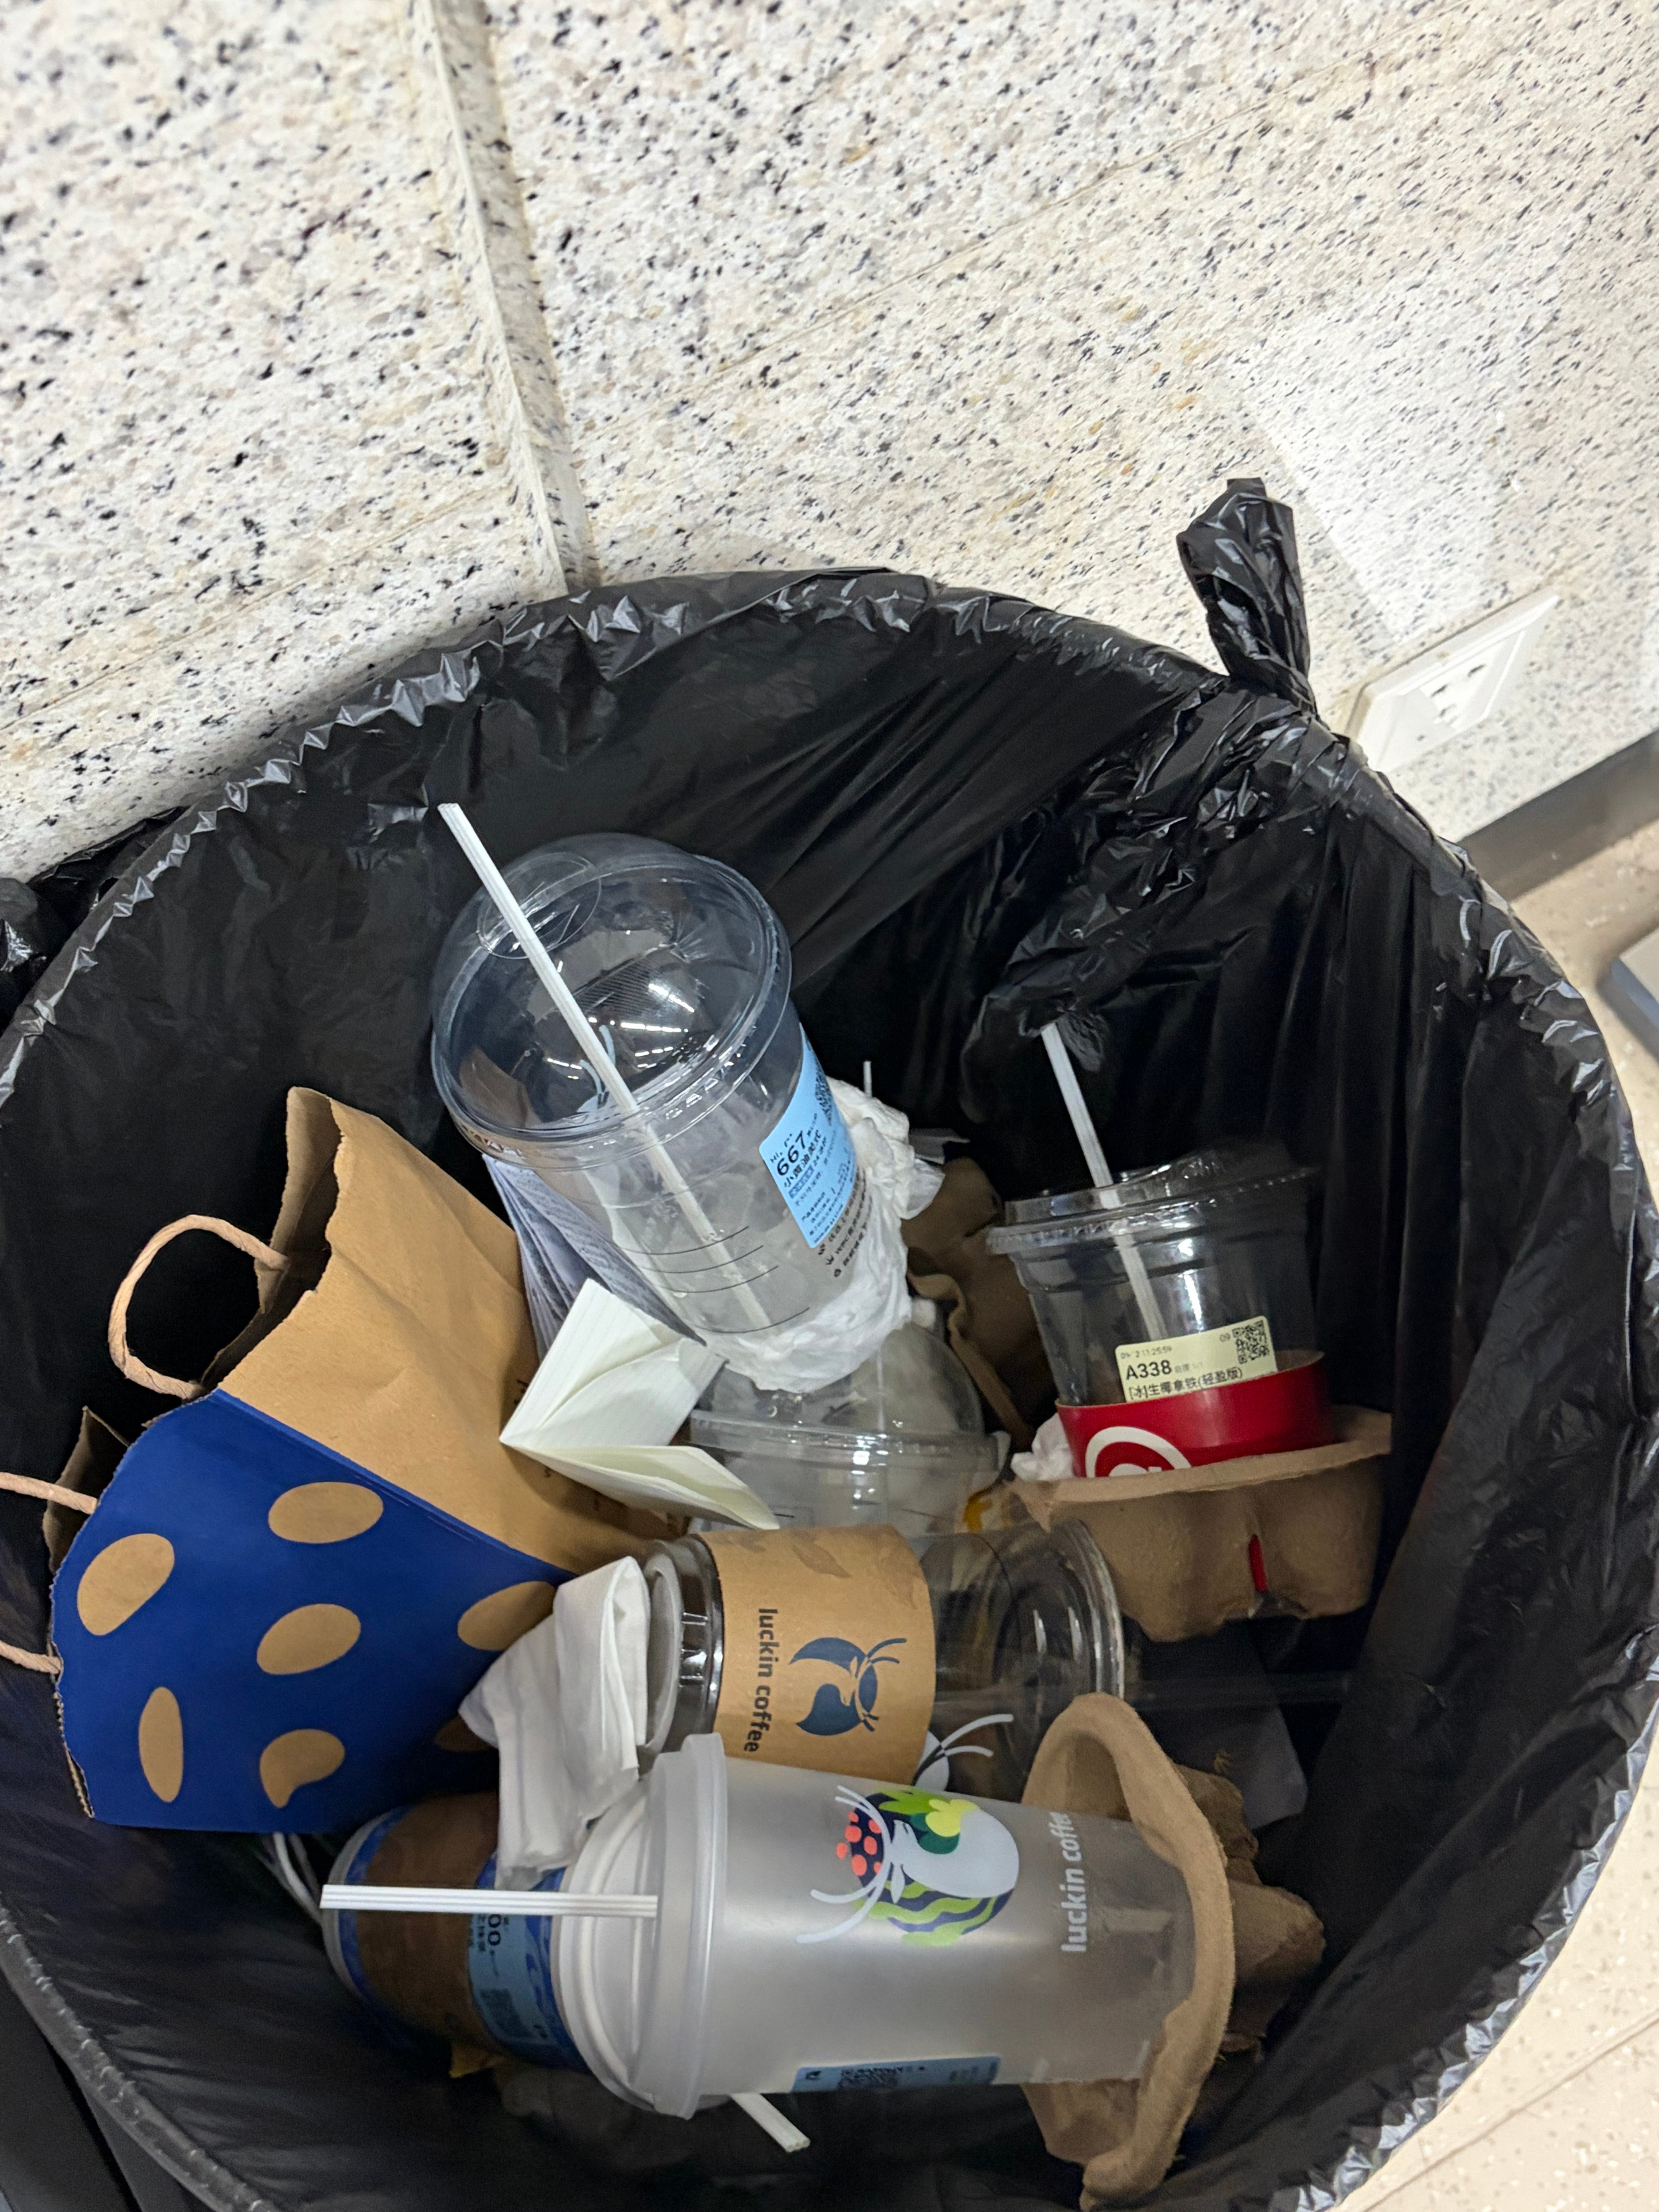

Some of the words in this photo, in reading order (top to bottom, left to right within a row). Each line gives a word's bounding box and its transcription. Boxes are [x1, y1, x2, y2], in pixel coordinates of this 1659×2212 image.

[777, 1130, 806, 1176] 667
[1126, 1359, 1172, 1380] A338
[758, 1608, 779, 1678] luckin
[744, 1685, 772, 1752] coffee
[1060, 1868, 1087, 1952] luckin
